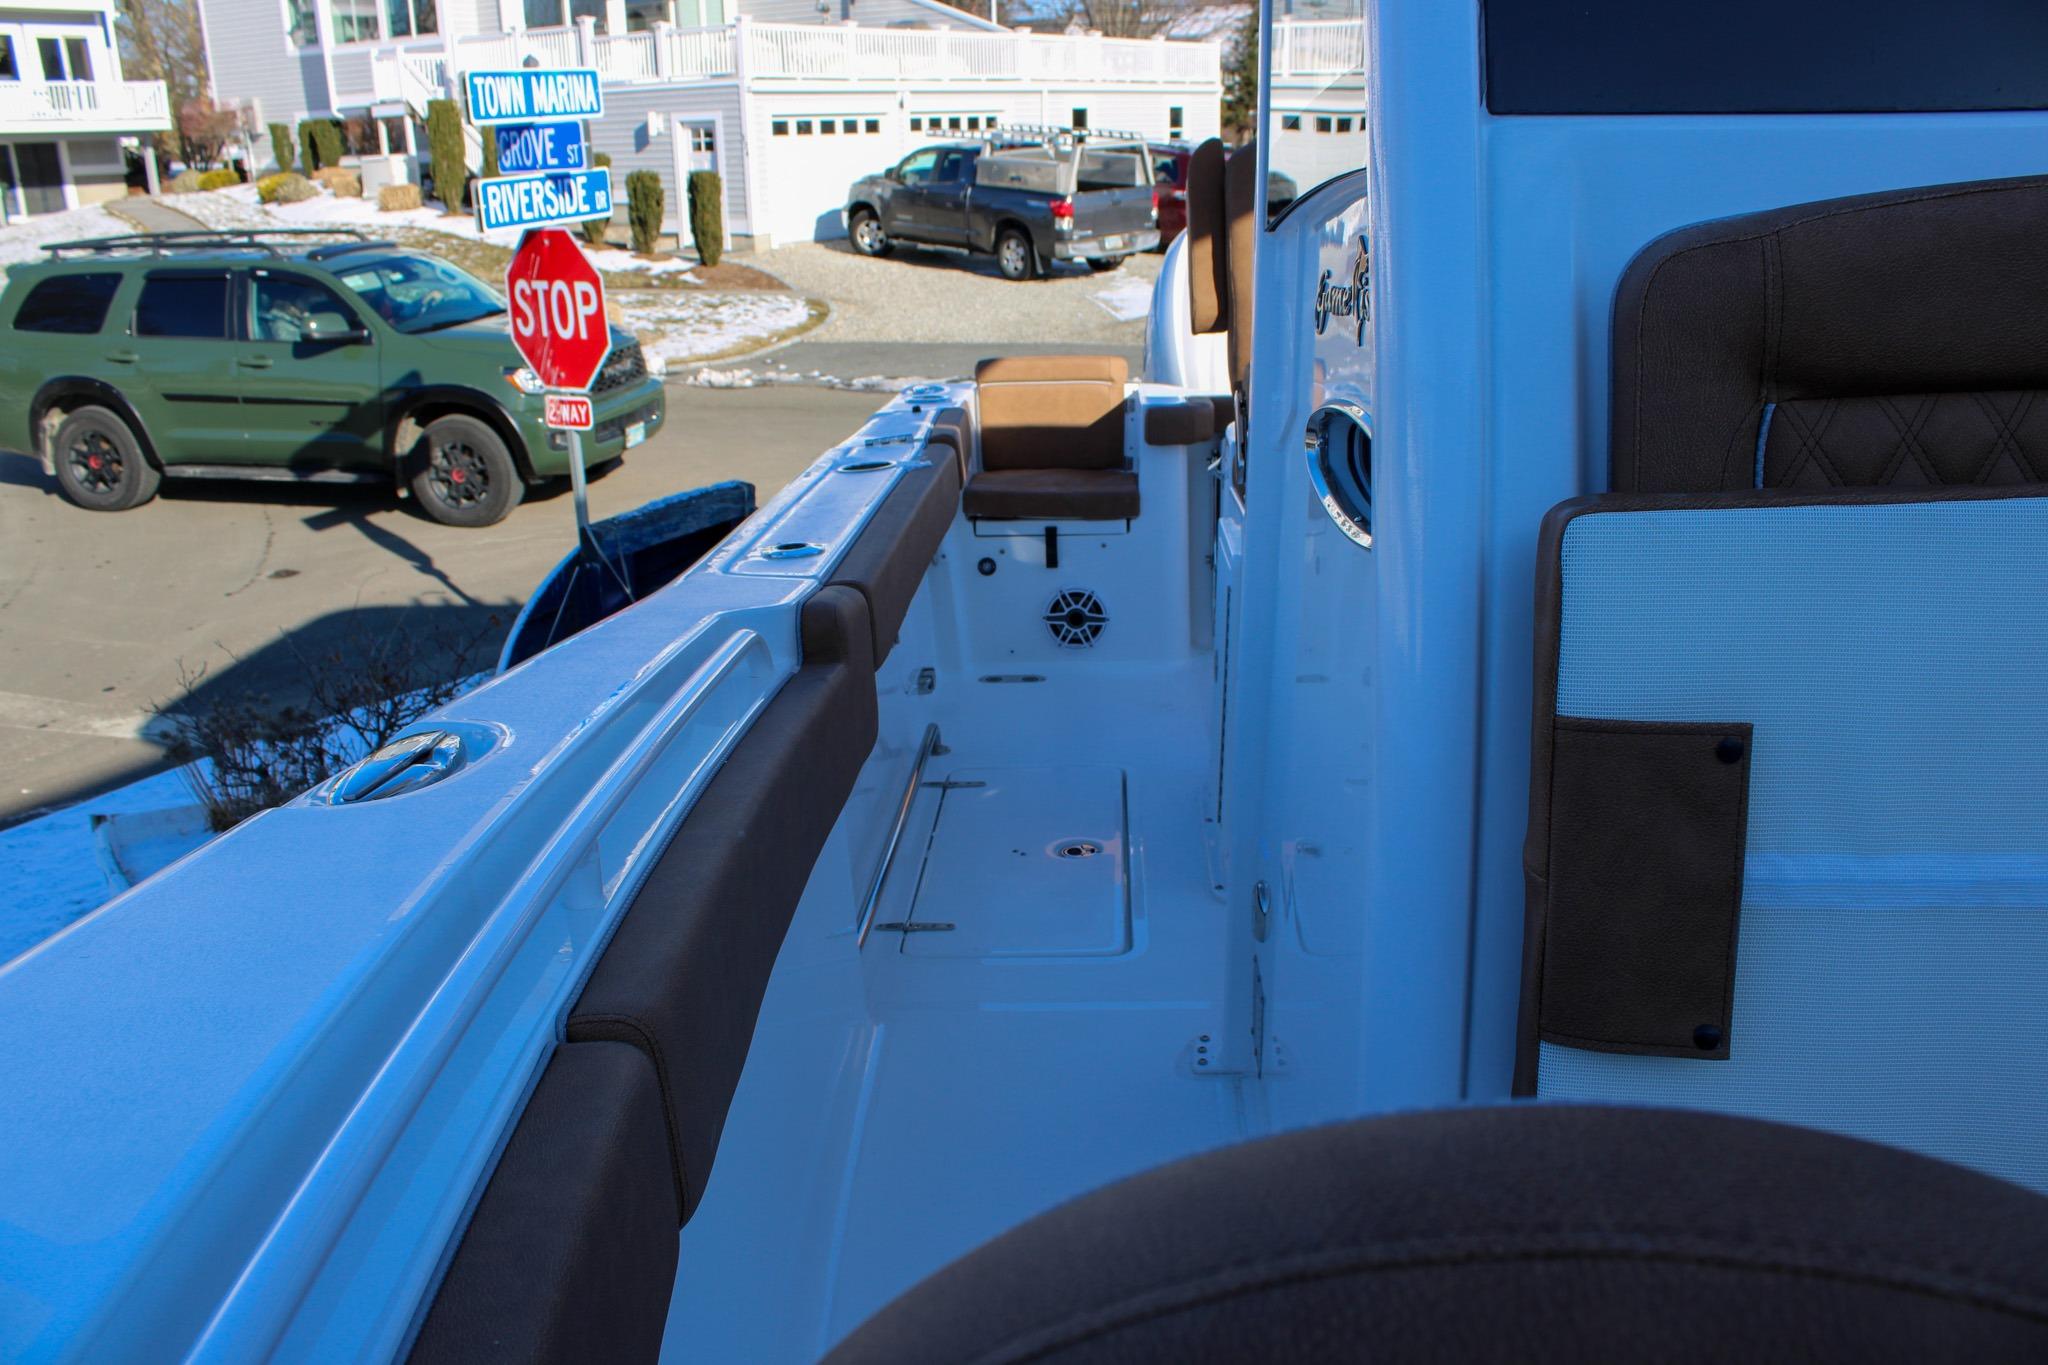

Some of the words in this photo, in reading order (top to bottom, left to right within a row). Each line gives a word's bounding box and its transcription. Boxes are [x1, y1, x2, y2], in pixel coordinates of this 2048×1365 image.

[473, 75, 526, 117] TOWN
[530, 74, 599, 114] MARINA
[500, 128, 559, 168] GROVE
[566, 145, 580, 165] ST
[486, 176, 590, 225] RIVERSIDE
[595, 190, 608, 210] DR
[514, 278, 598, 340] STOP
[549, 402, 587, 423] 2-WAY
